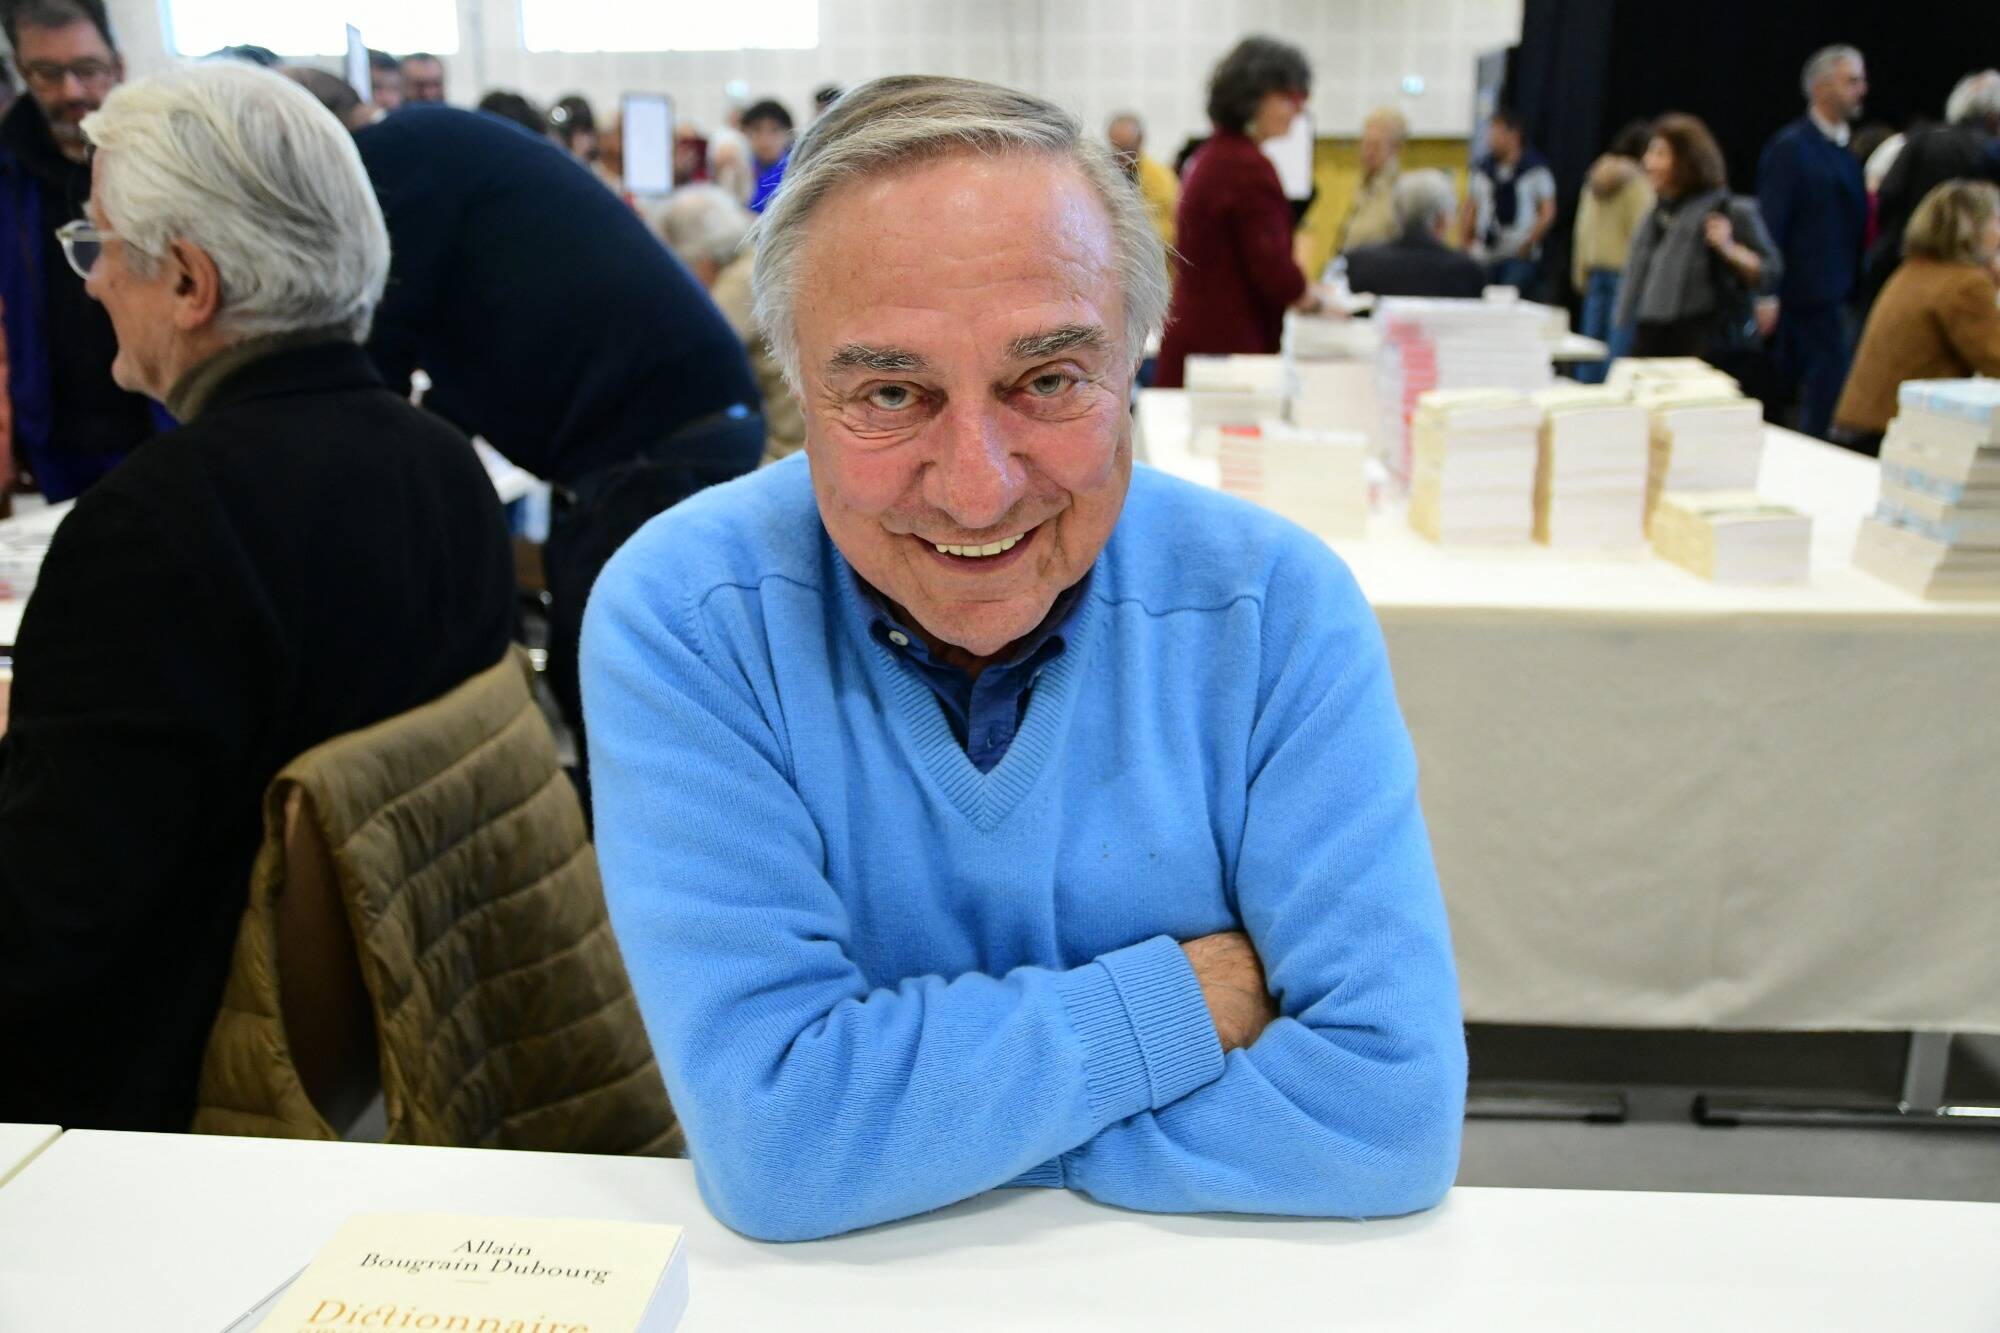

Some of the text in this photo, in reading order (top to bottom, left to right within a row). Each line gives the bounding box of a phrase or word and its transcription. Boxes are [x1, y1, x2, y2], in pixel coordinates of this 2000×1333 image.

[452, 1239, 532, 1256] Allain
[360, 1253, 613, 1285] Bougrain Dubourg
[307, 1299, 590, 1333] Dictionnaire
